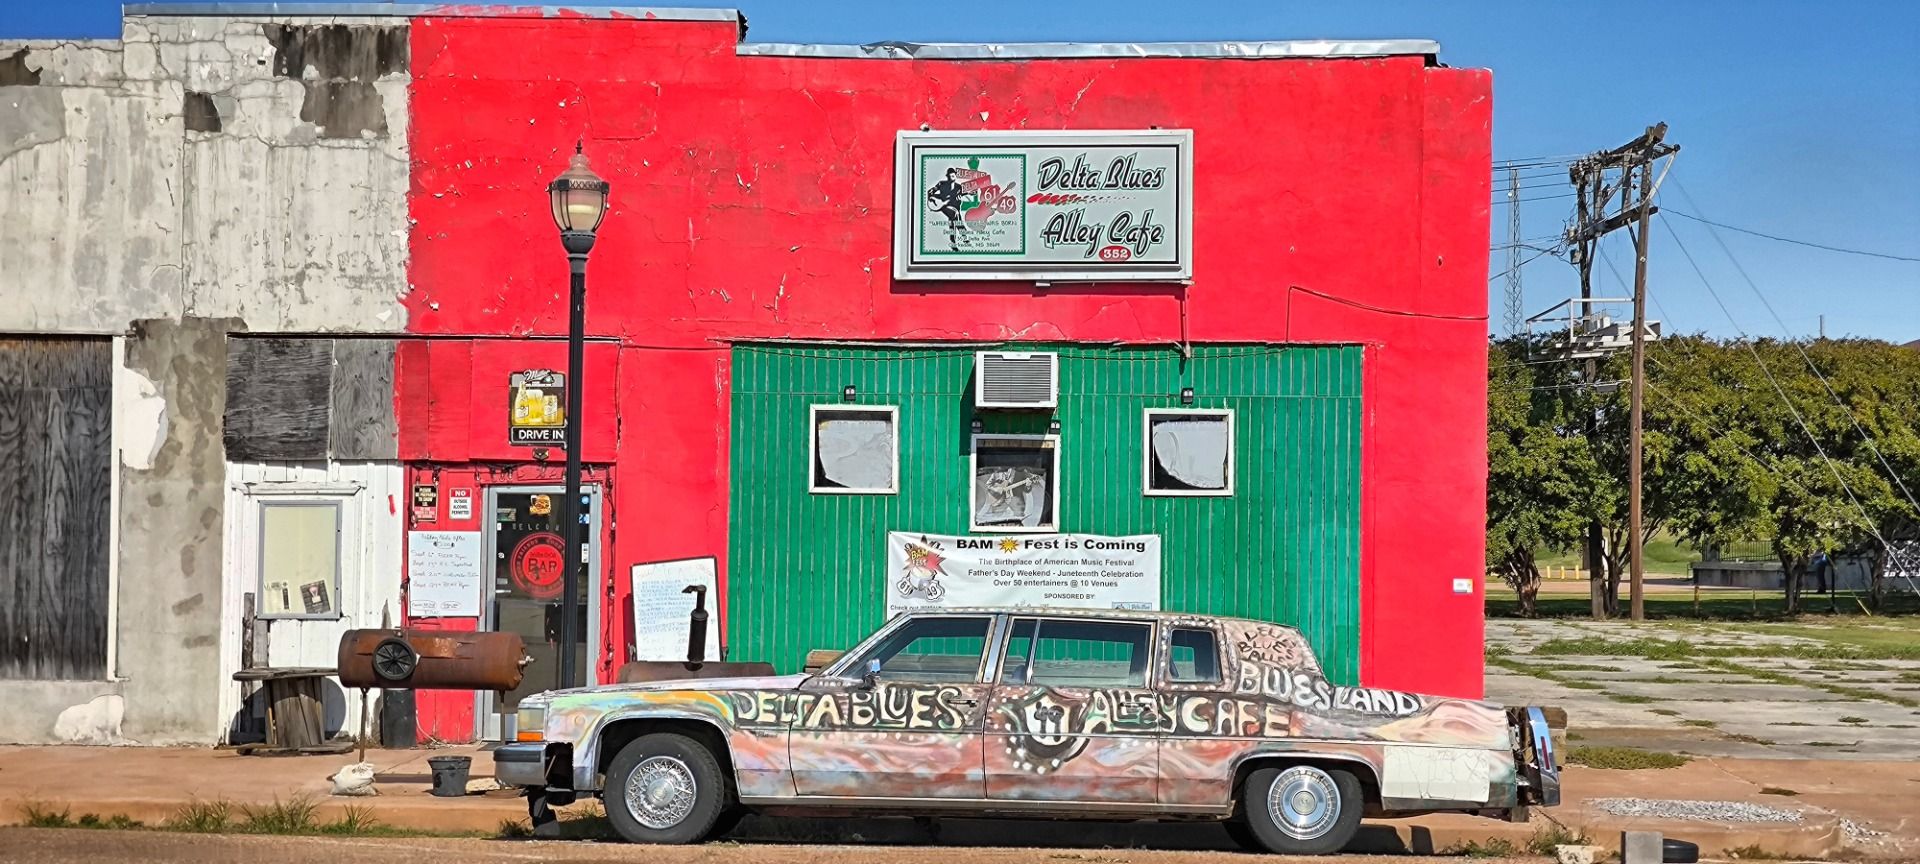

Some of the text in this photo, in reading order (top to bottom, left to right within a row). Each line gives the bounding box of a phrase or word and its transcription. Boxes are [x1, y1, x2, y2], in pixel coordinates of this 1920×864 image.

[1038, 152, 1166, 191] Delta Blues
[984, 188, 996, 200] 61
[1000, 199, 1014, 210] 49
[1040, 208, 1165, 258] Alley Cafe
[1103, 249, 1129, 259] 352
[518, 429, 564, 440] DRIVE IN
[512, 523, 560, 532] WELCOM
[957, 539, 1145, 552] BAM Fest is Coming
[912, 549, 928, 560] BAM
[528, 558, 557, 574] BAR
[995, 558, 1032, 567] Birthplace
[1043, 558, 1079, 566] American
[1081, 558, 1103, 566] Music
[1000, 569, 1015, 578] Day
[1057, 569, 1099, 577] Juneteenth
[1100, 570, 1144, 578] Celebration
[900, 581, 910, 593] 61
[993, 579, 1011, 587] Over
[1024, 579, 1068, 587] entertainers
[1070, 579, 1079, 588] @
[1080, 579, 1089, 587] 10
[927, 585, 938, 597] 49
[1237, 640, 1294, 660] BLUES
[734, 685, 964, 730] DELTA BLUES
[1082, 690, 1290, 738] ALLEY CAFE
[1034, 701, 1065, 742] 49
